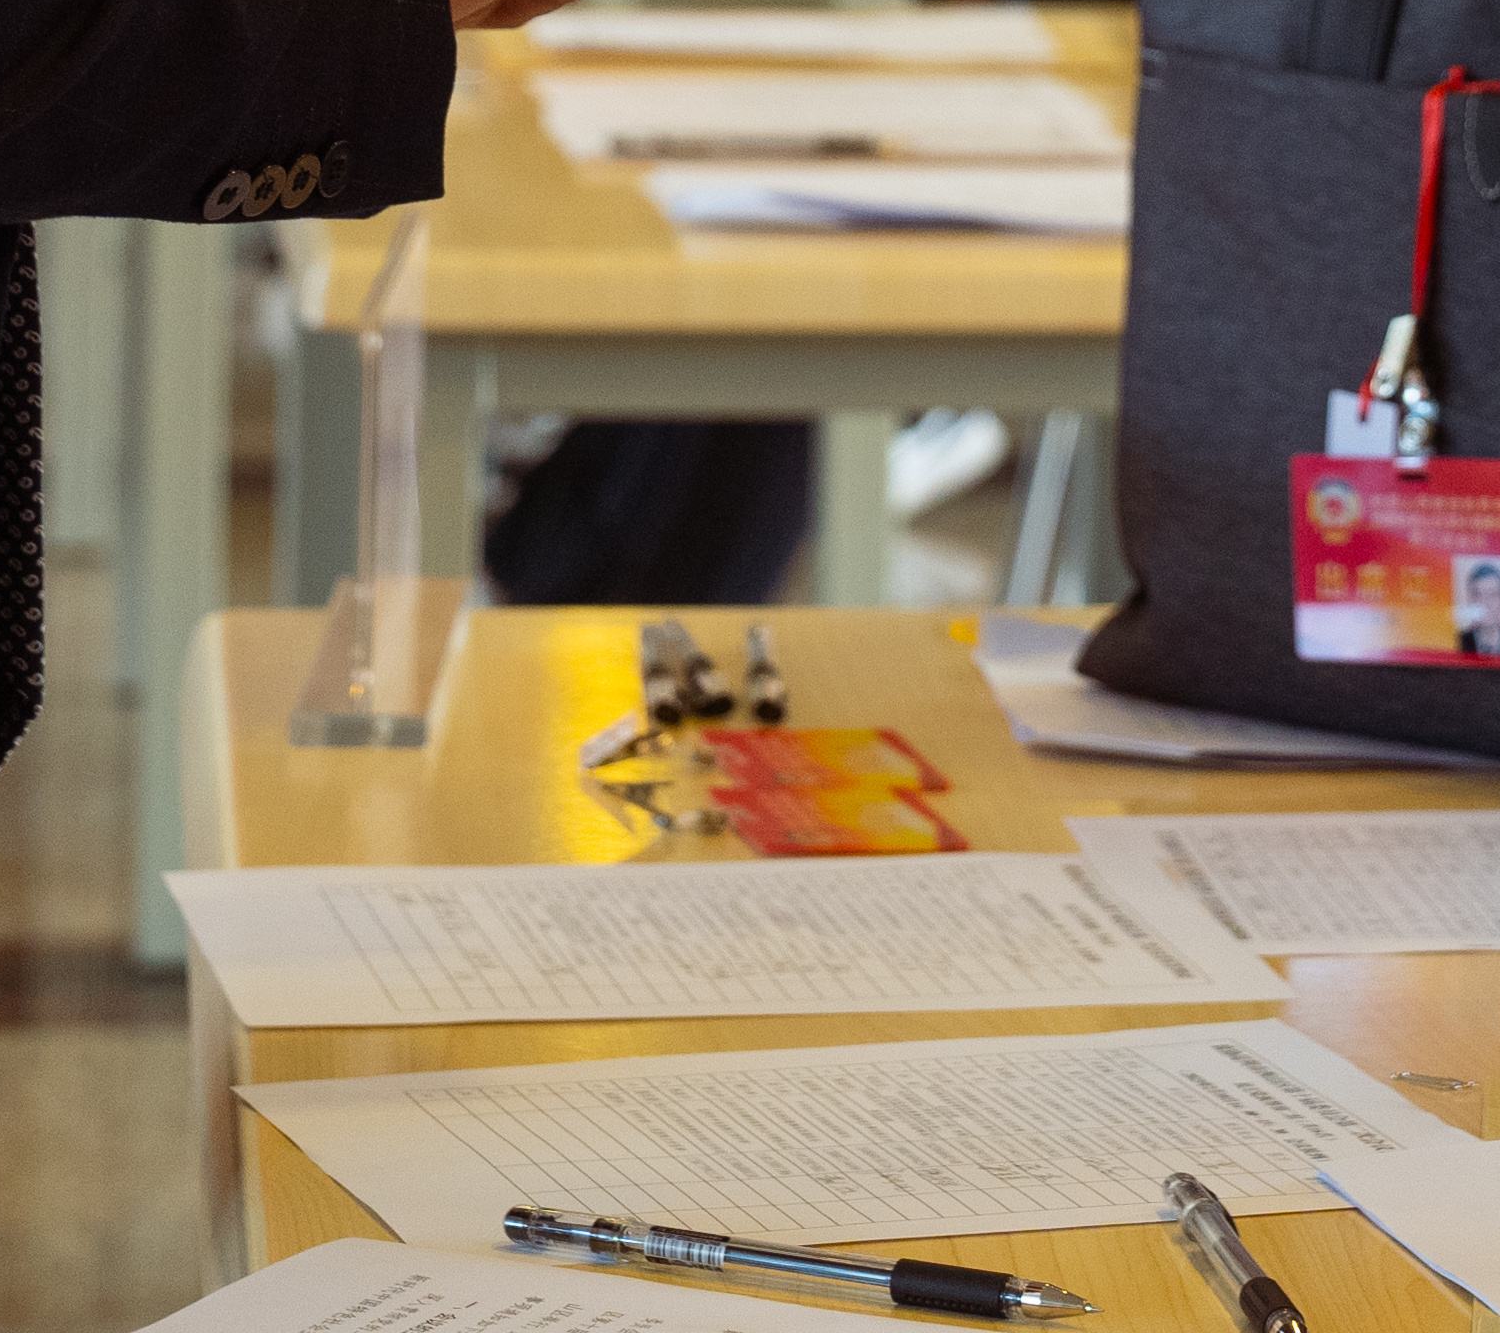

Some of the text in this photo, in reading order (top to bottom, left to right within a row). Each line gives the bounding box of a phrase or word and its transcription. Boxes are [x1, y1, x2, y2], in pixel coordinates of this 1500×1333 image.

[294, 1273, 437, 1333] 新时代中国特色社会
[349, 1292, 449, 1333] 深入贯彻党的
[399, 1299, 488, 1333] 一、会议的
